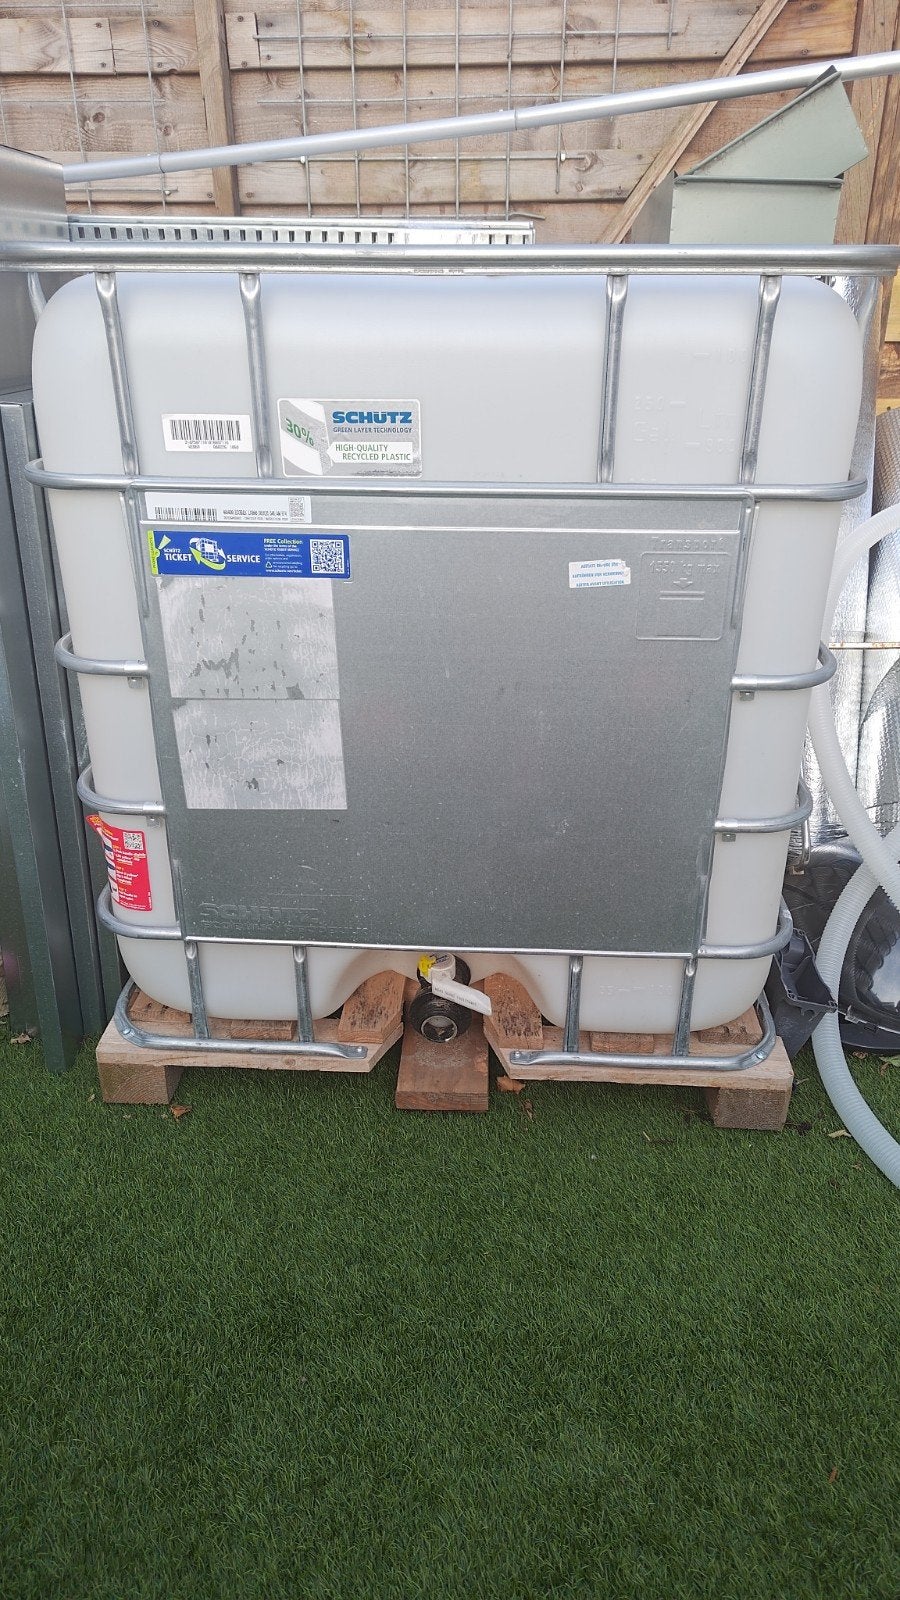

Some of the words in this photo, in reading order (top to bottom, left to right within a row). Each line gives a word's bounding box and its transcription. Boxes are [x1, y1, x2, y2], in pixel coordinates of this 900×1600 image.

[332, 411, 413, 424] SCHÜTZ
[285, 417, 315, 448] 30%
[335, 444, 389, 452] HIGH-QUALITY
[342, 453, 380, 461] RECYCLED
[381, 453, 412, 461] PLASTIC
[164, 553, 192, 562] TICKET
[227, 554, 261, 563] SERVICE
